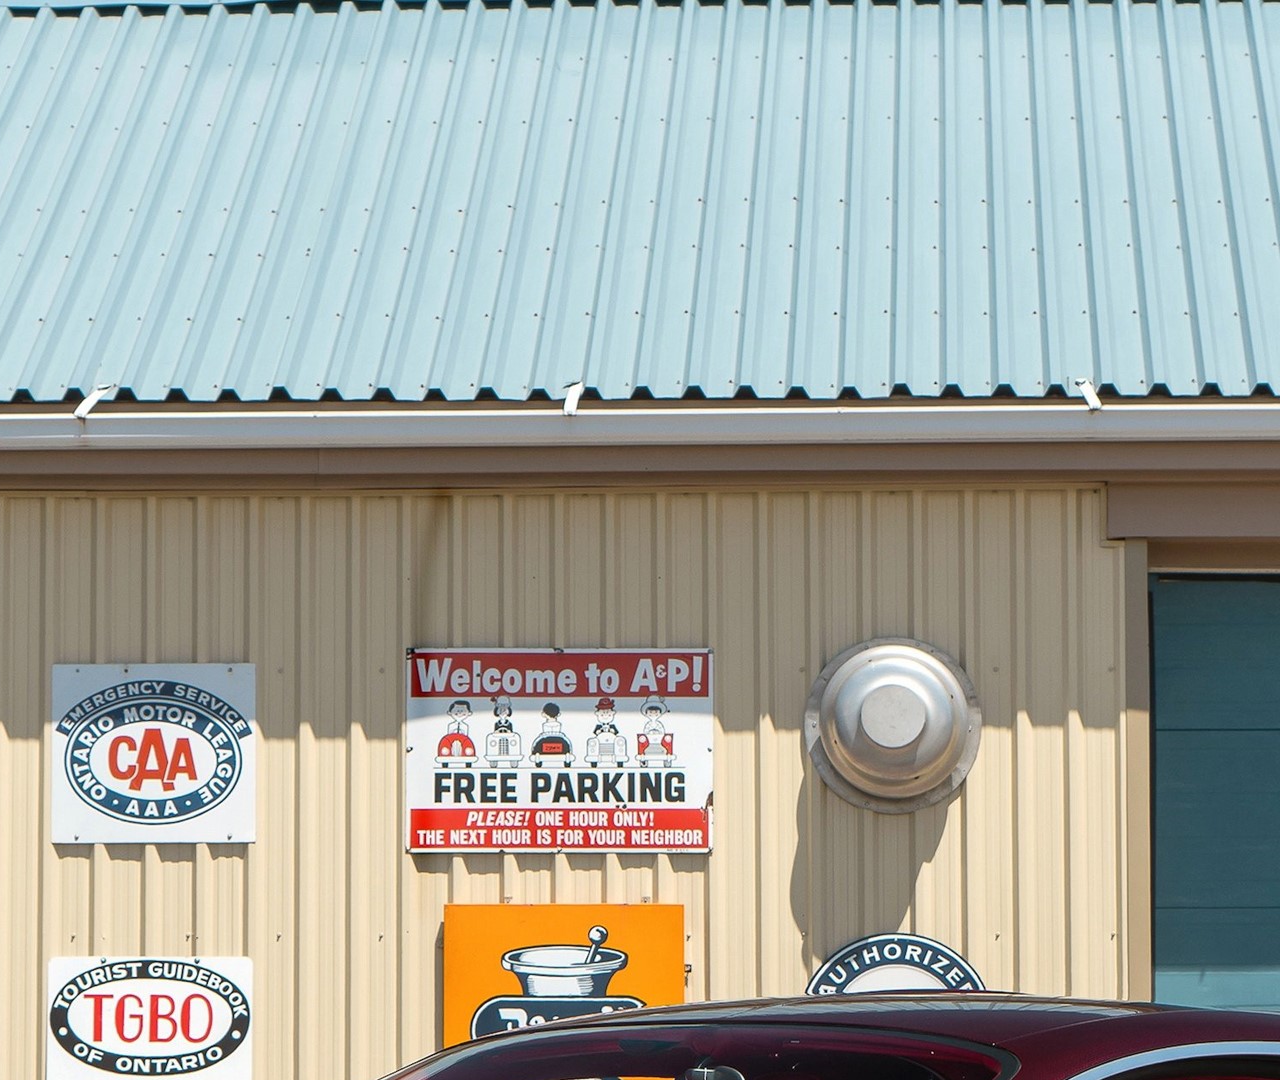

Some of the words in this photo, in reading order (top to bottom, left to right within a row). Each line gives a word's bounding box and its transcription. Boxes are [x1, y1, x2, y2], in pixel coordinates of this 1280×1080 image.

[416, 657, 578, 694] Welcome
[584, 663, 619, 694] to
[630, 656, 702, 693] A&P!
[60, 681, 165, 733] EMERGENCY
[173, 684, 248, 734] SERVICE
[72, 715, 115, 801] ONTARIO
[123, 705, 197, 728] MOTOR
[197, 722, 234, 805] LEAGUE
[108, 728, 198, 792] CAA
[124, 800, 179, 817] AAA
[433, 772, 518, 804] FREE
[530, 771, 686, 804] PARKING
[417, 830, 446, 845] THE
[450, 829, 487, 845] NEXT
[491, 829, 531, 845] HOUR
[536, 829, 552, 845] IS
[556, 829, 584, 845] FOR
[588, 829, 625, 845] YOUR
[630, 829, 702, 845] NEIGHBOR
[466, 812, 530, 827] PLEASE!
[535, 811, 566, 827] ONE
[569, 811, 609, 827] HOUR
[613, 811, 654, 827] ONLY!
[53, 962, 143, 1010] TOURIST
[148, 962, 249, 1019] GUIDEBOOK
[818, 943, 973, 995] AUTHORIZE
[83, 993, 213, 1043] TGBO
[73, 1043, 104, 1064] OF
[115, 1046, 223, 1073] ONTARIO
